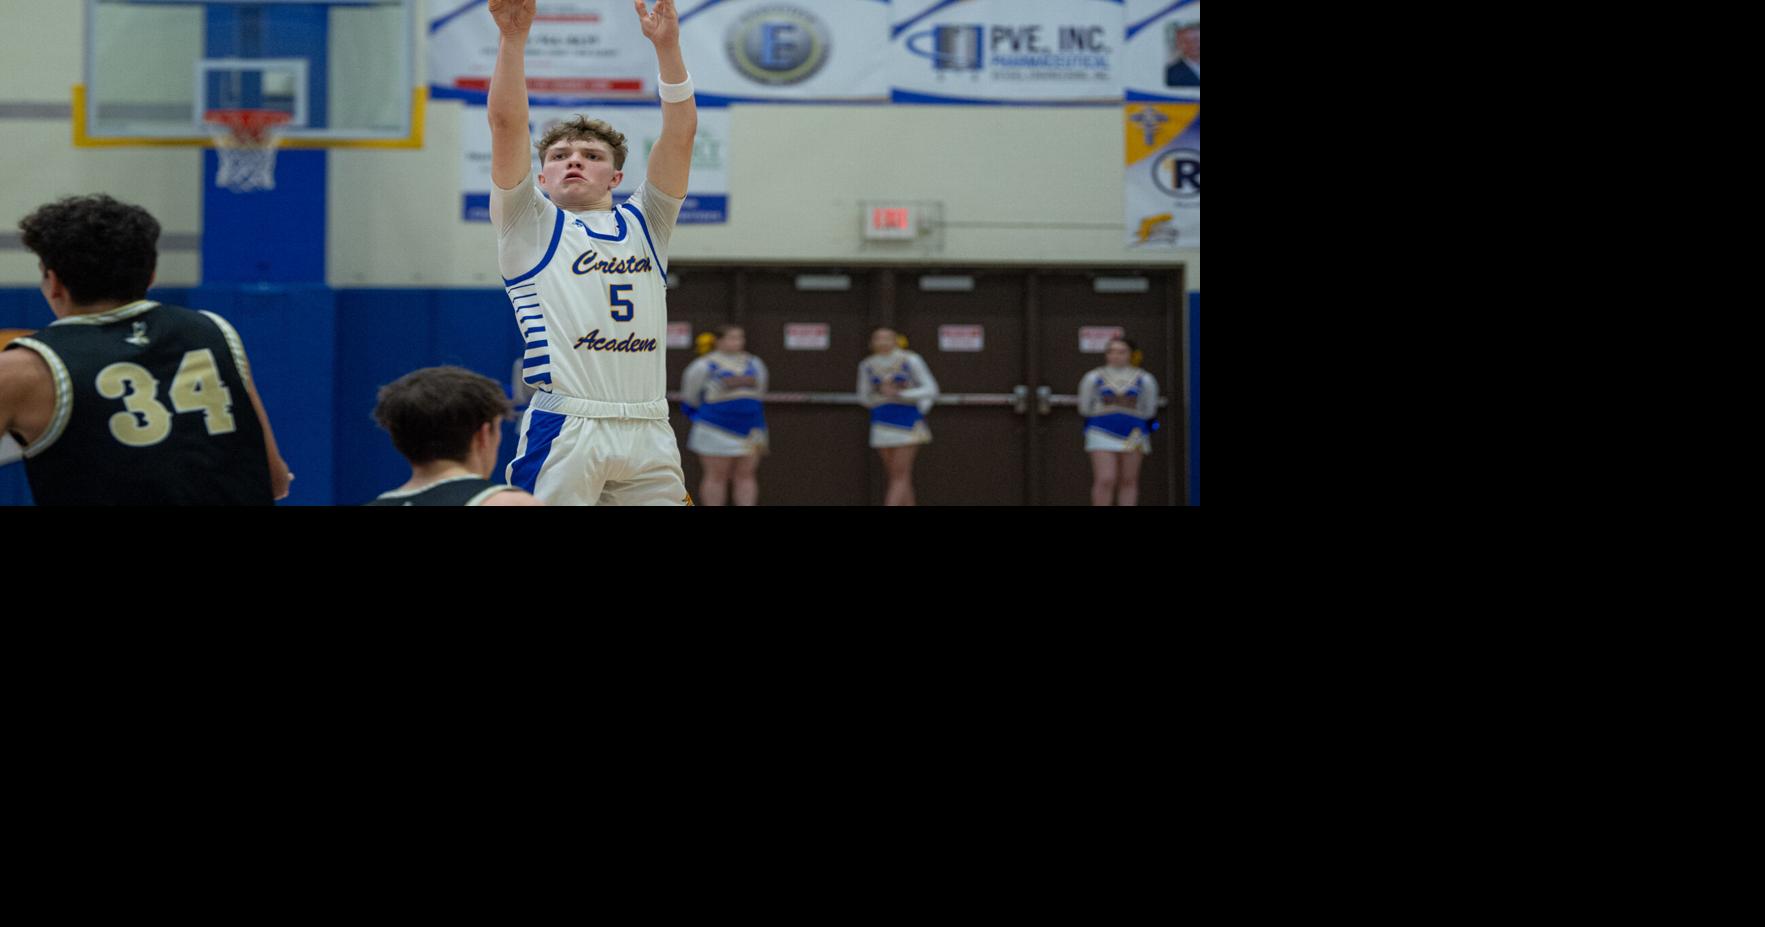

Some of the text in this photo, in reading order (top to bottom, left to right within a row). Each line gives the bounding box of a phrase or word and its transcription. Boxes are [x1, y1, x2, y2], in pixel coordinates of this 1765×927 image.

[609, 283, 635, 323] 5
[573, 328, 657, 353] Academ
[94, 347, 237, 447] 34
